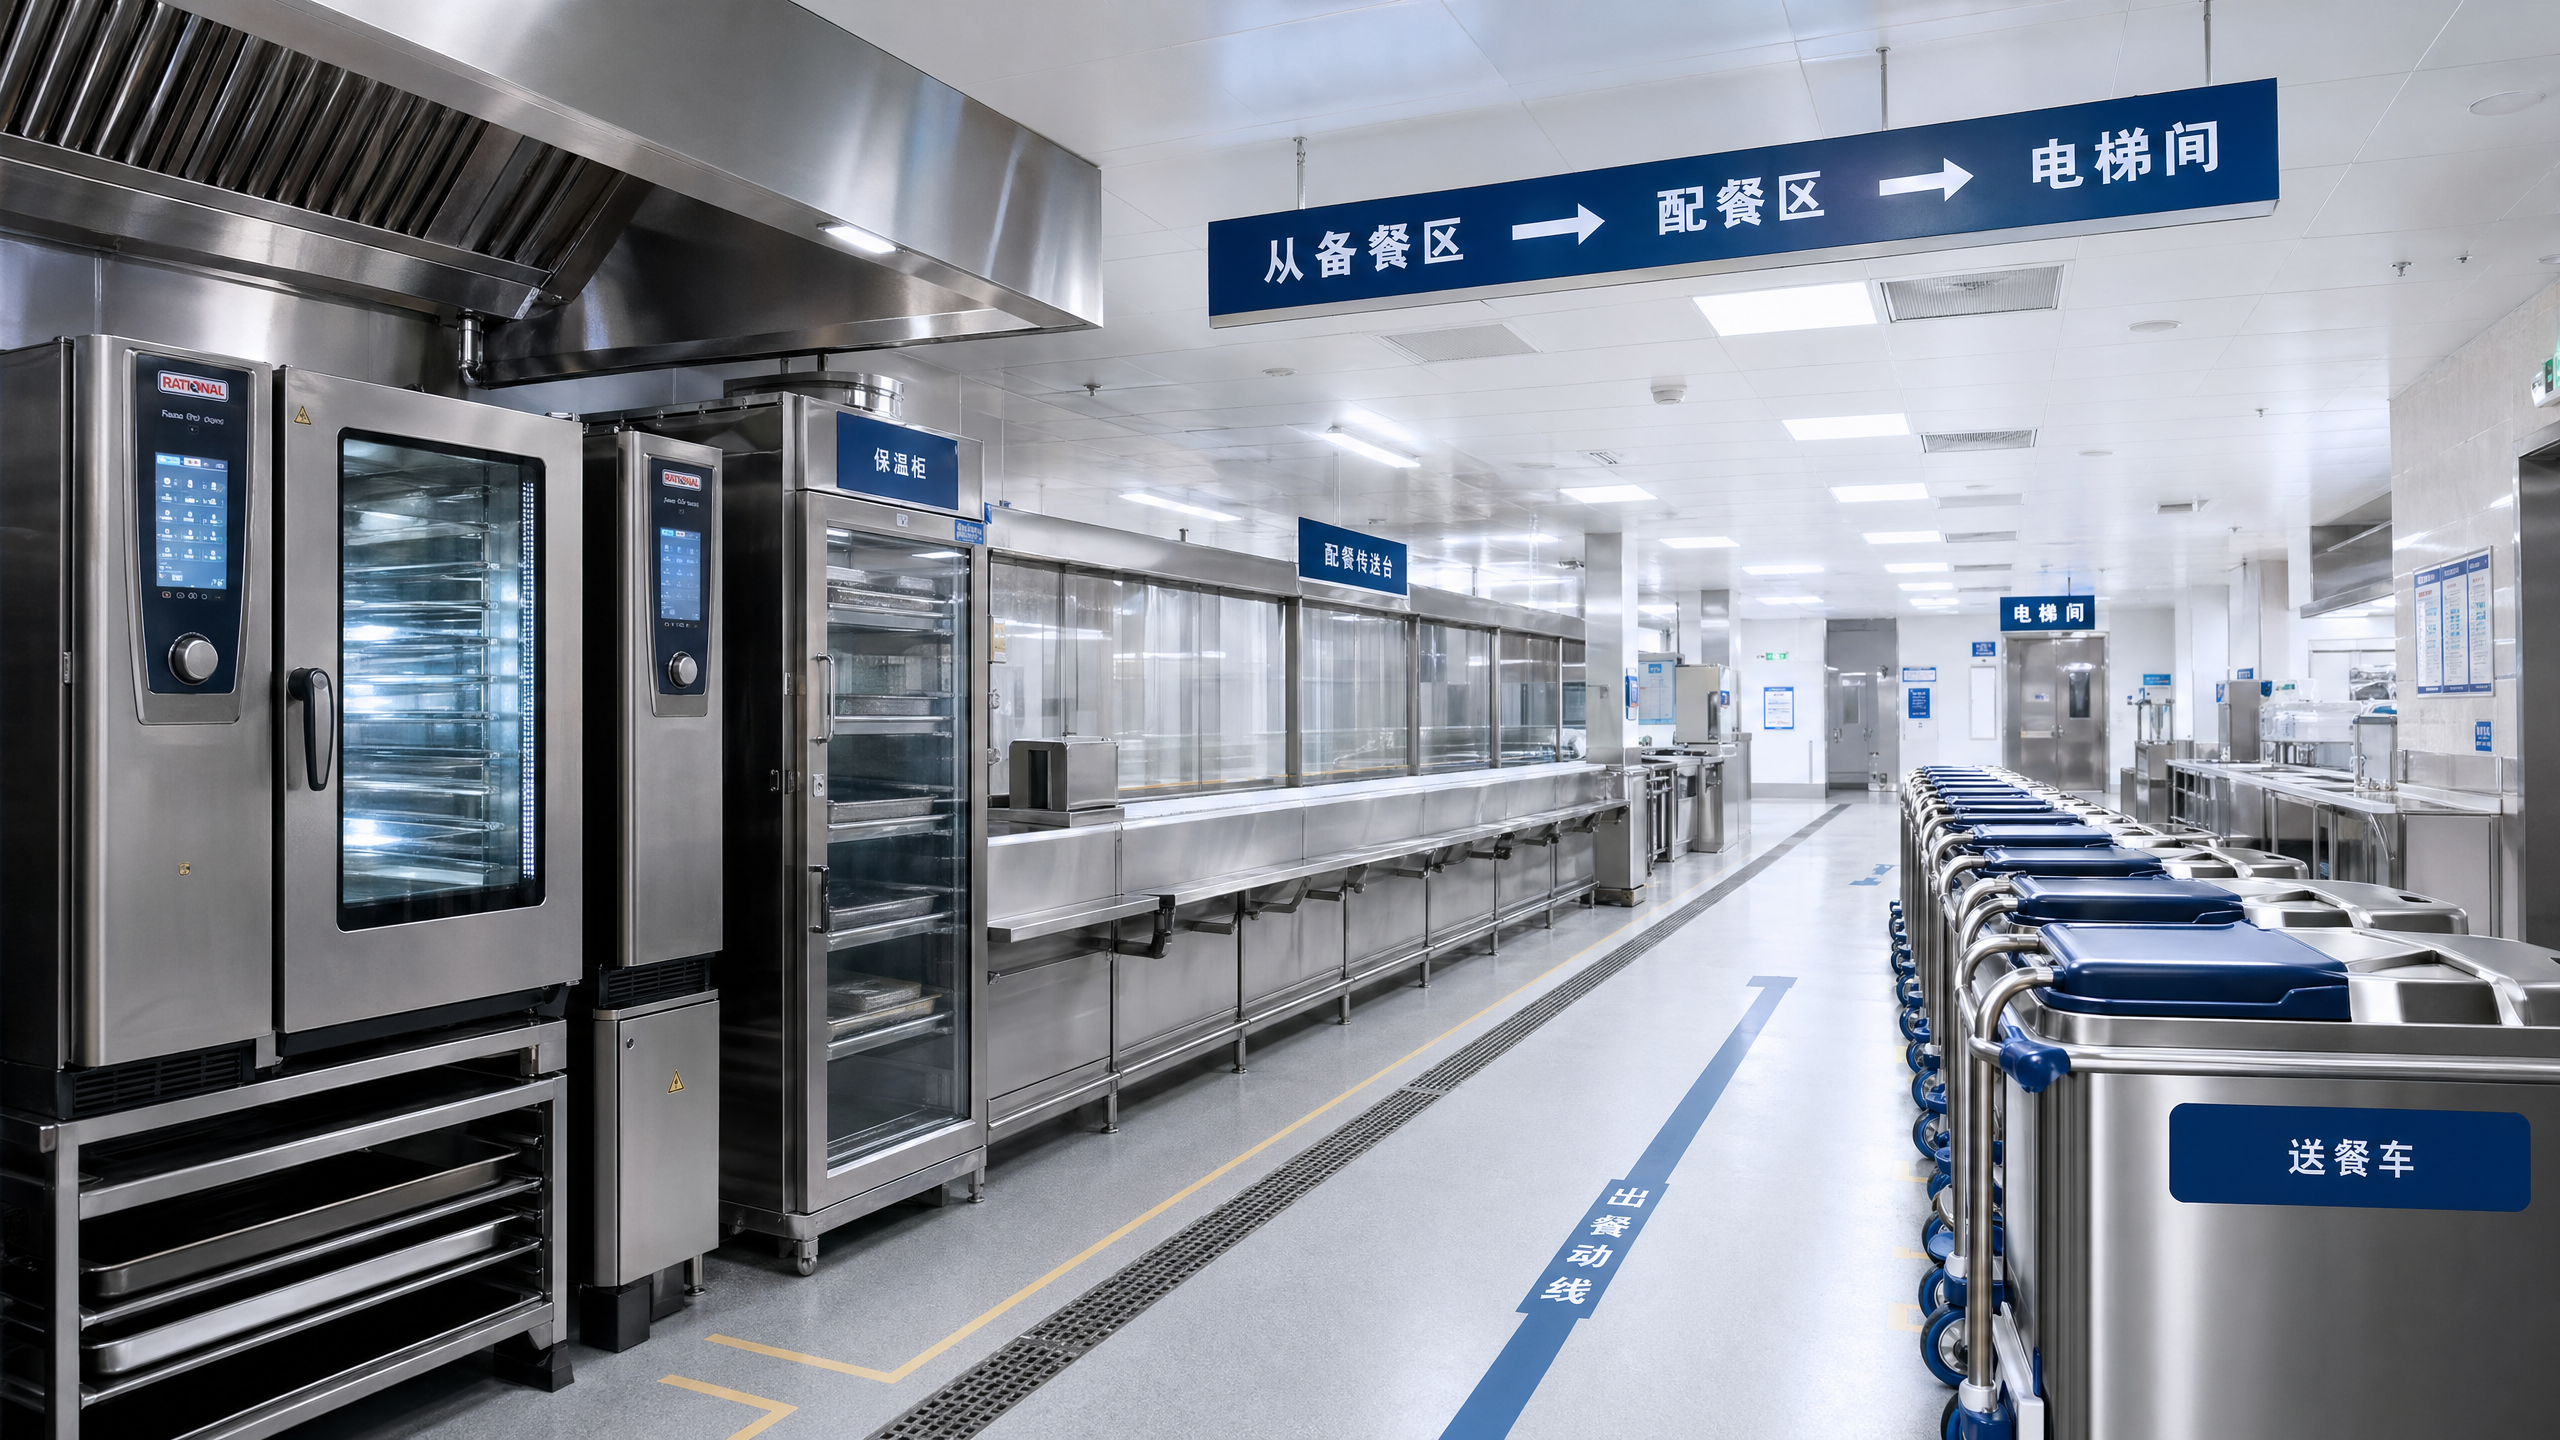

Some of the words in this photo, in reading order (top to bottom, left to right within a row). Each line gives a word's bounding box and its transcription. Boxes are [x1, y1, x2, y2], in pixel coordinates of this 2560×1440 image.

[1264, 217, 1464, 285] 从备餐区
[1656, 170, 1825, 236] 配餐区
[2030, 121, 2219, 190] 电梯间
[873, 447, 927, 480] 保温柜
[1324, 542, 1393, 579] 配餐传送台
[2013, 602, 2085, 624] 电梯间
[2288, 1138, 2415, 1179] 送餐车
[1540, 1187, 1650, 1305] 出餐动线
